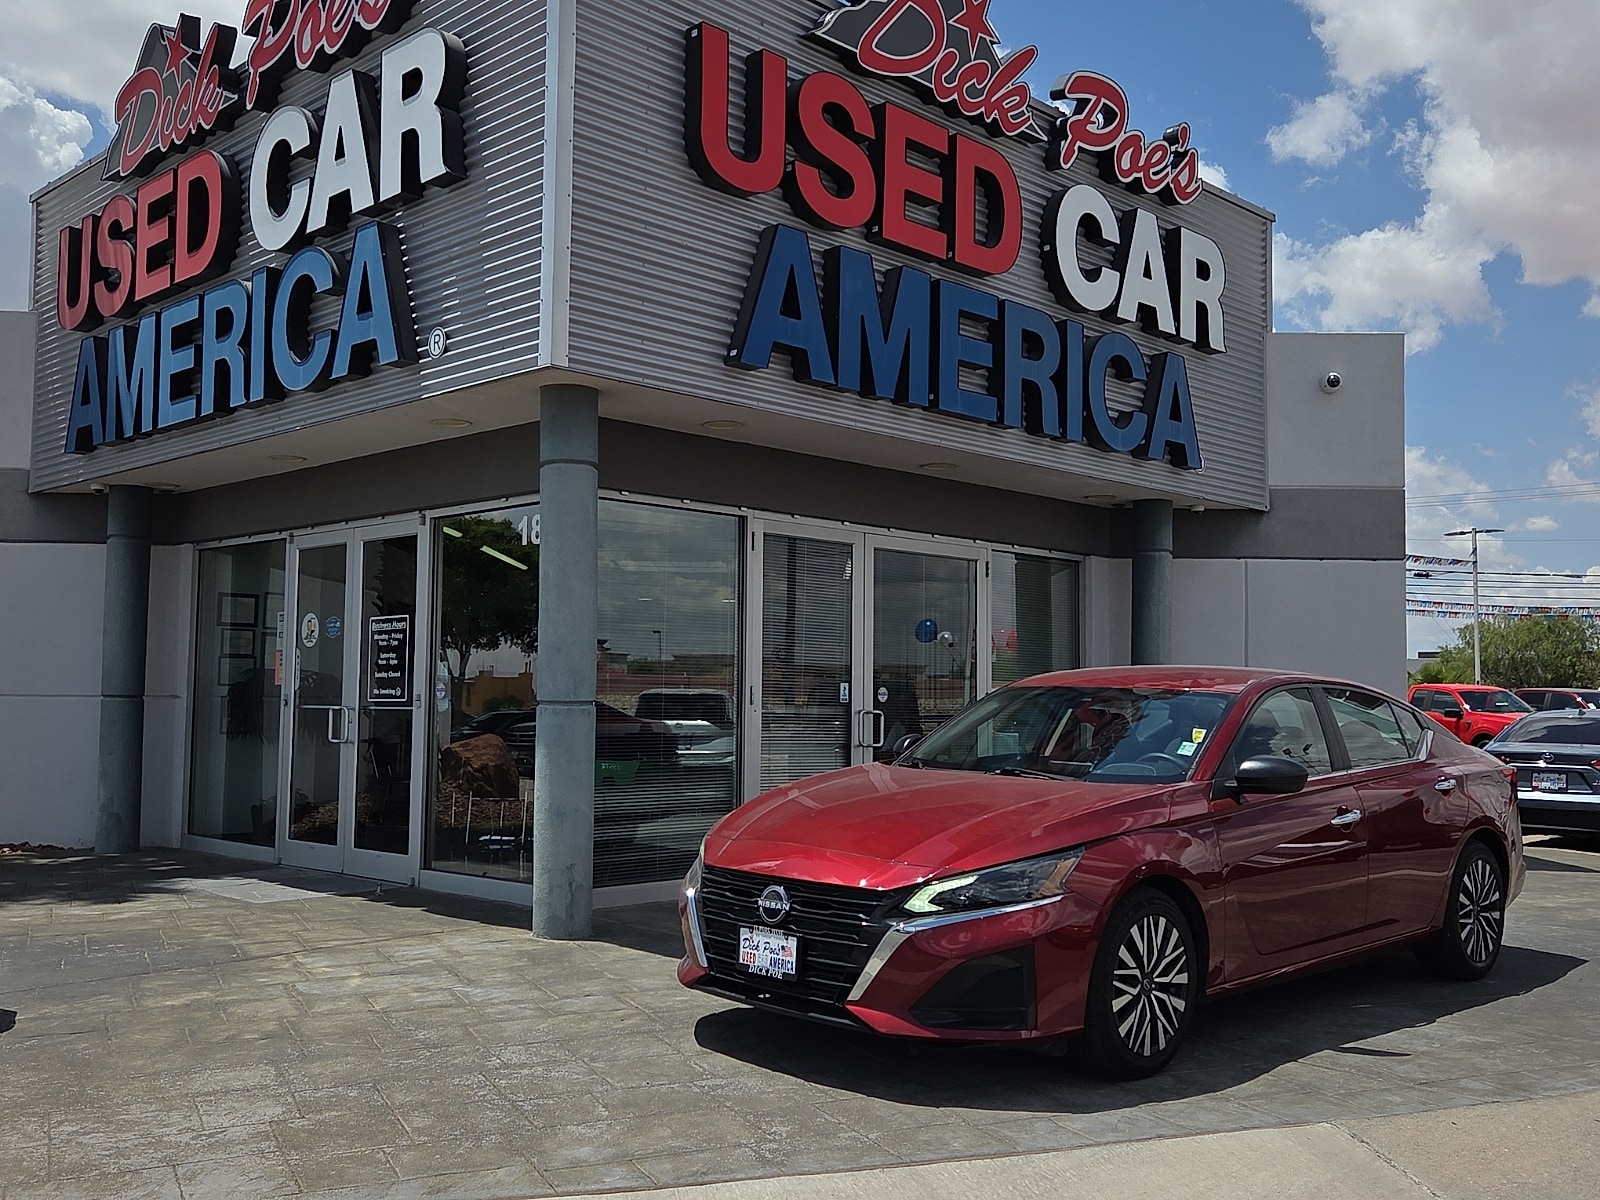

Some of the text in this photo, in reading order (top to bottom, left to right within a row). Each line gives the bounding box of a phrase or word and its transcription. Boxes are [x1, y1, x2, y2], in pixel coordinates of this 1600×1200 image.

[115, 0, 392, 176] Dick Poe
[857, 0, 1203, 205] Dick Poe's
[57, 27, 450, 332] USED CAR
[699, 21, 1227, 353] USED CAR
[64, 221, 400, 454] AMERICA
[736, 223, 1202, 469] AMERICA
[372, 621, 406, 631] Business Hours
[742, 937, 780, 956] Dick Poe's
[742, 951, 756, 964] USED
[769, 956, 794, 973] AMERICA
[749, 965, 784, 980] DICK POE
[758, 899, 790, 911] NISSAN
